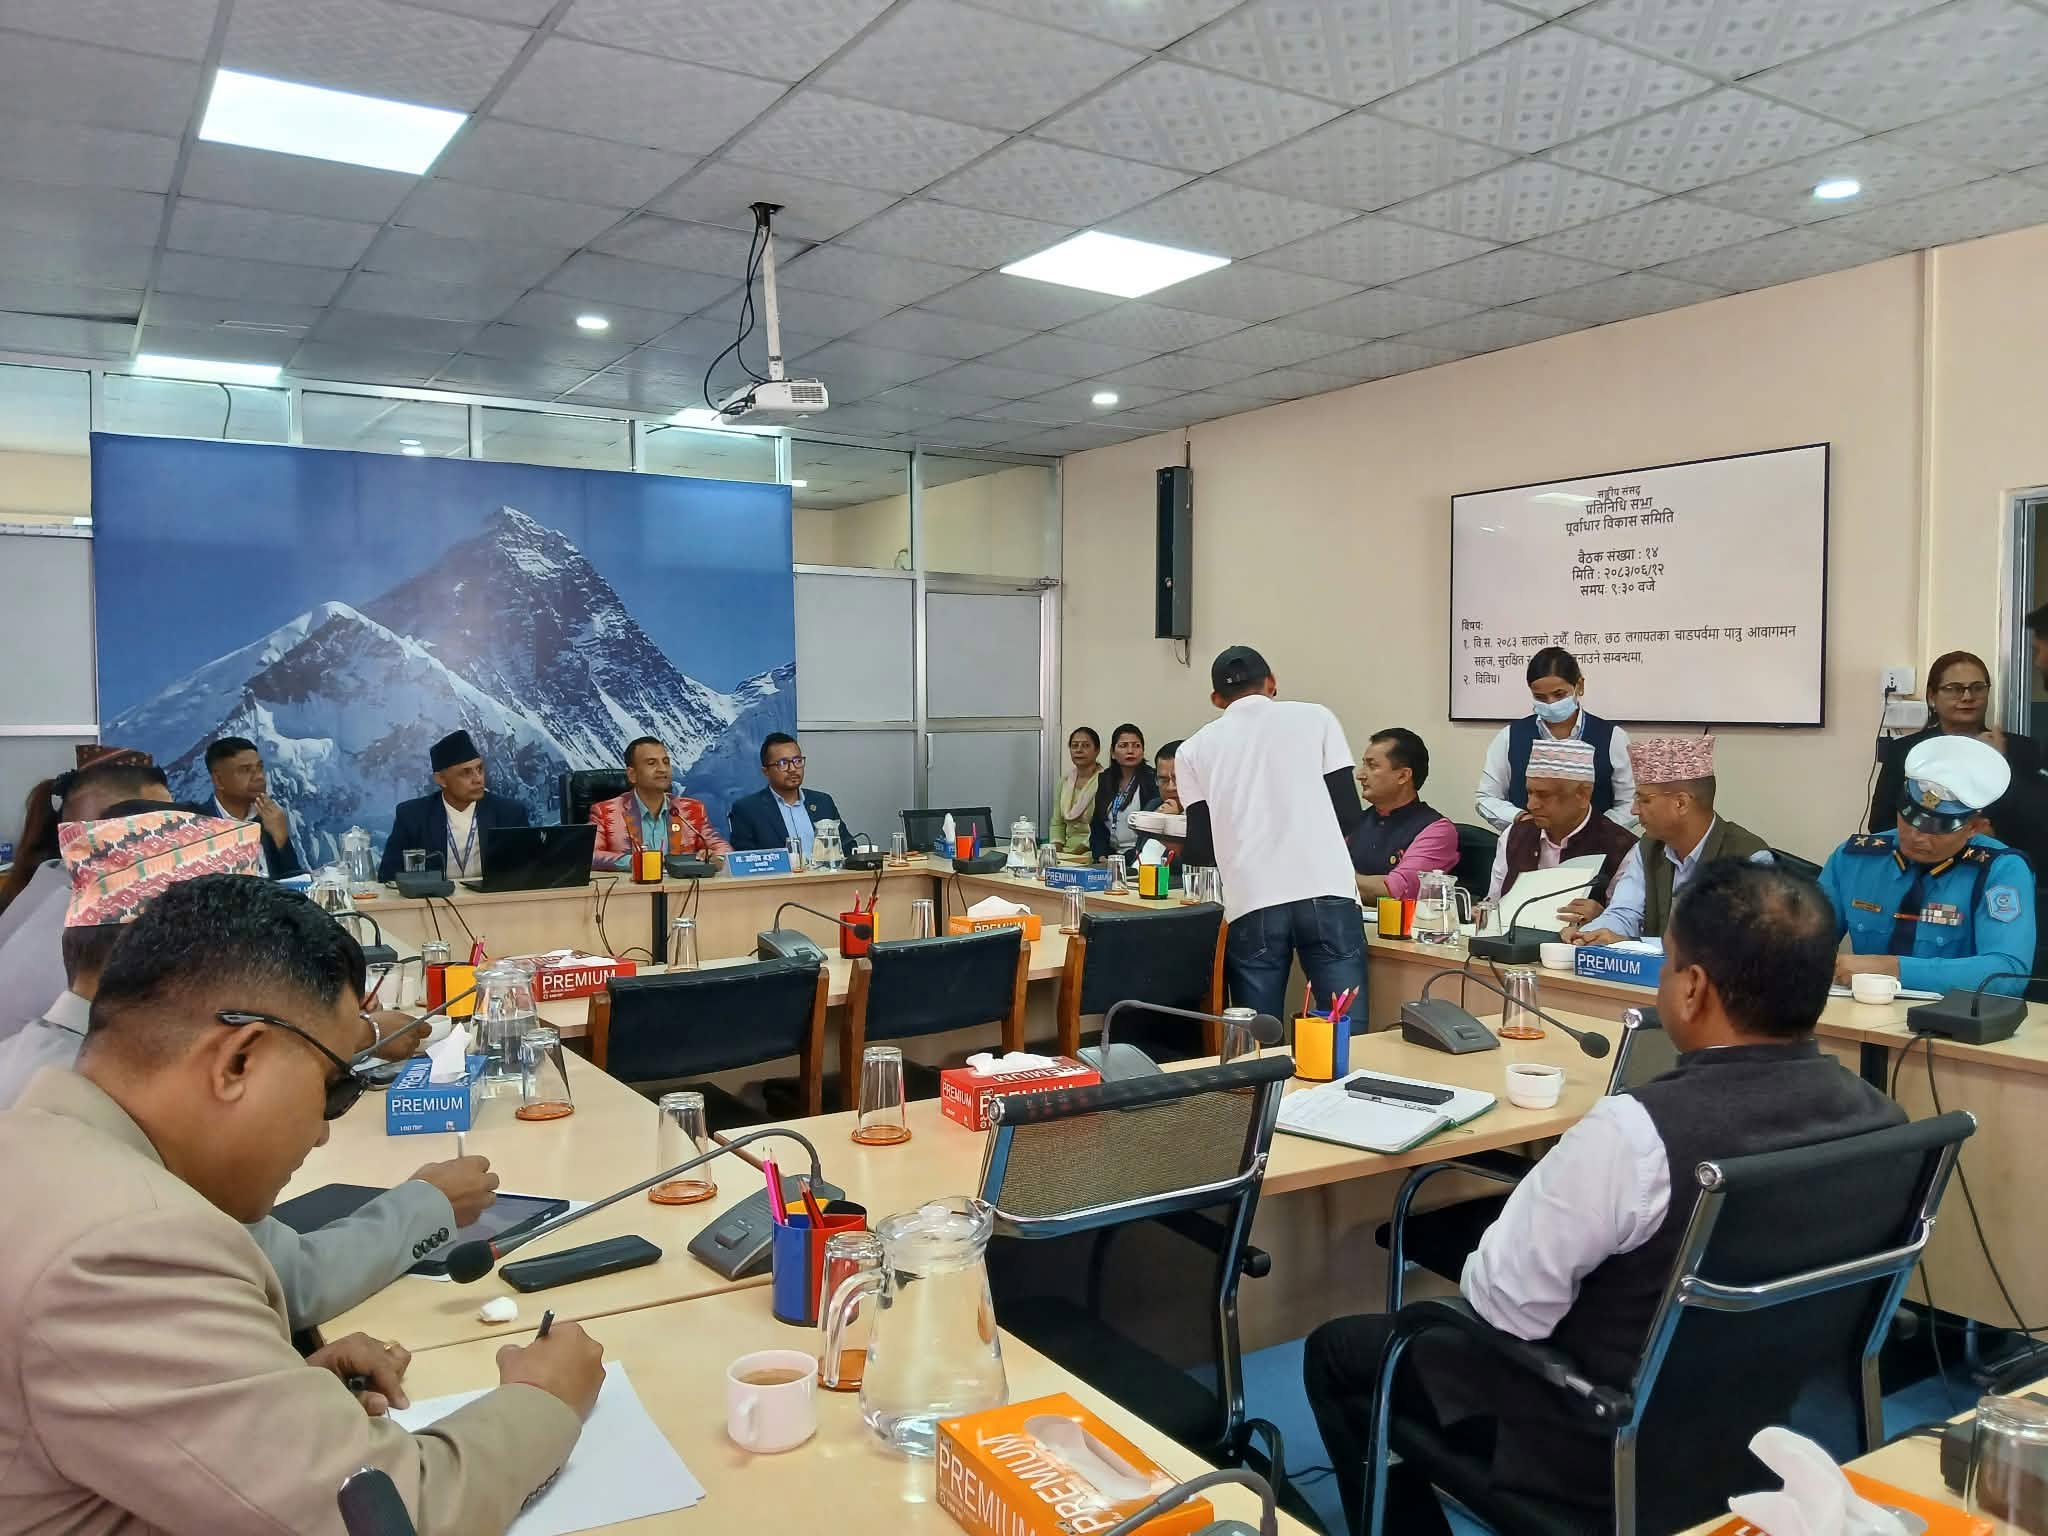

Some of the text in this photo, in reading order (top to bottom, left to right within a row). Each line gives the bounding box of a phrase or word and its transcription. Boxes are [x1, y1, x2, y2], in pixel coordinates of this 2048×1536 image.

[1586, 496, 1653, 515] प्रतिनिधि सभा
[1566, 507, 1675, 536] पूर्वाधार विकास समिति
[1645, 546, 1659, 560] १४
[1572, 565, 1595, 581] मिति
[1604, 563, 1665, 580] २०८३/०६/१२
[1604, 632, 1621, 644] छठ
[1624, 630, 1671, 643] लगायतका
[1673, 624, 1721, 640] चाडपर्वमा
[1747, 625, 1797, 639] आवागमन
[1046, 871, 1077, 884] PREMIUM
[1577, 953, 1641, 975] PREMIUM
[943, 1081, 972, 1108] PREMIUM
[391, 1096, 463, 1113] PREMIUM
